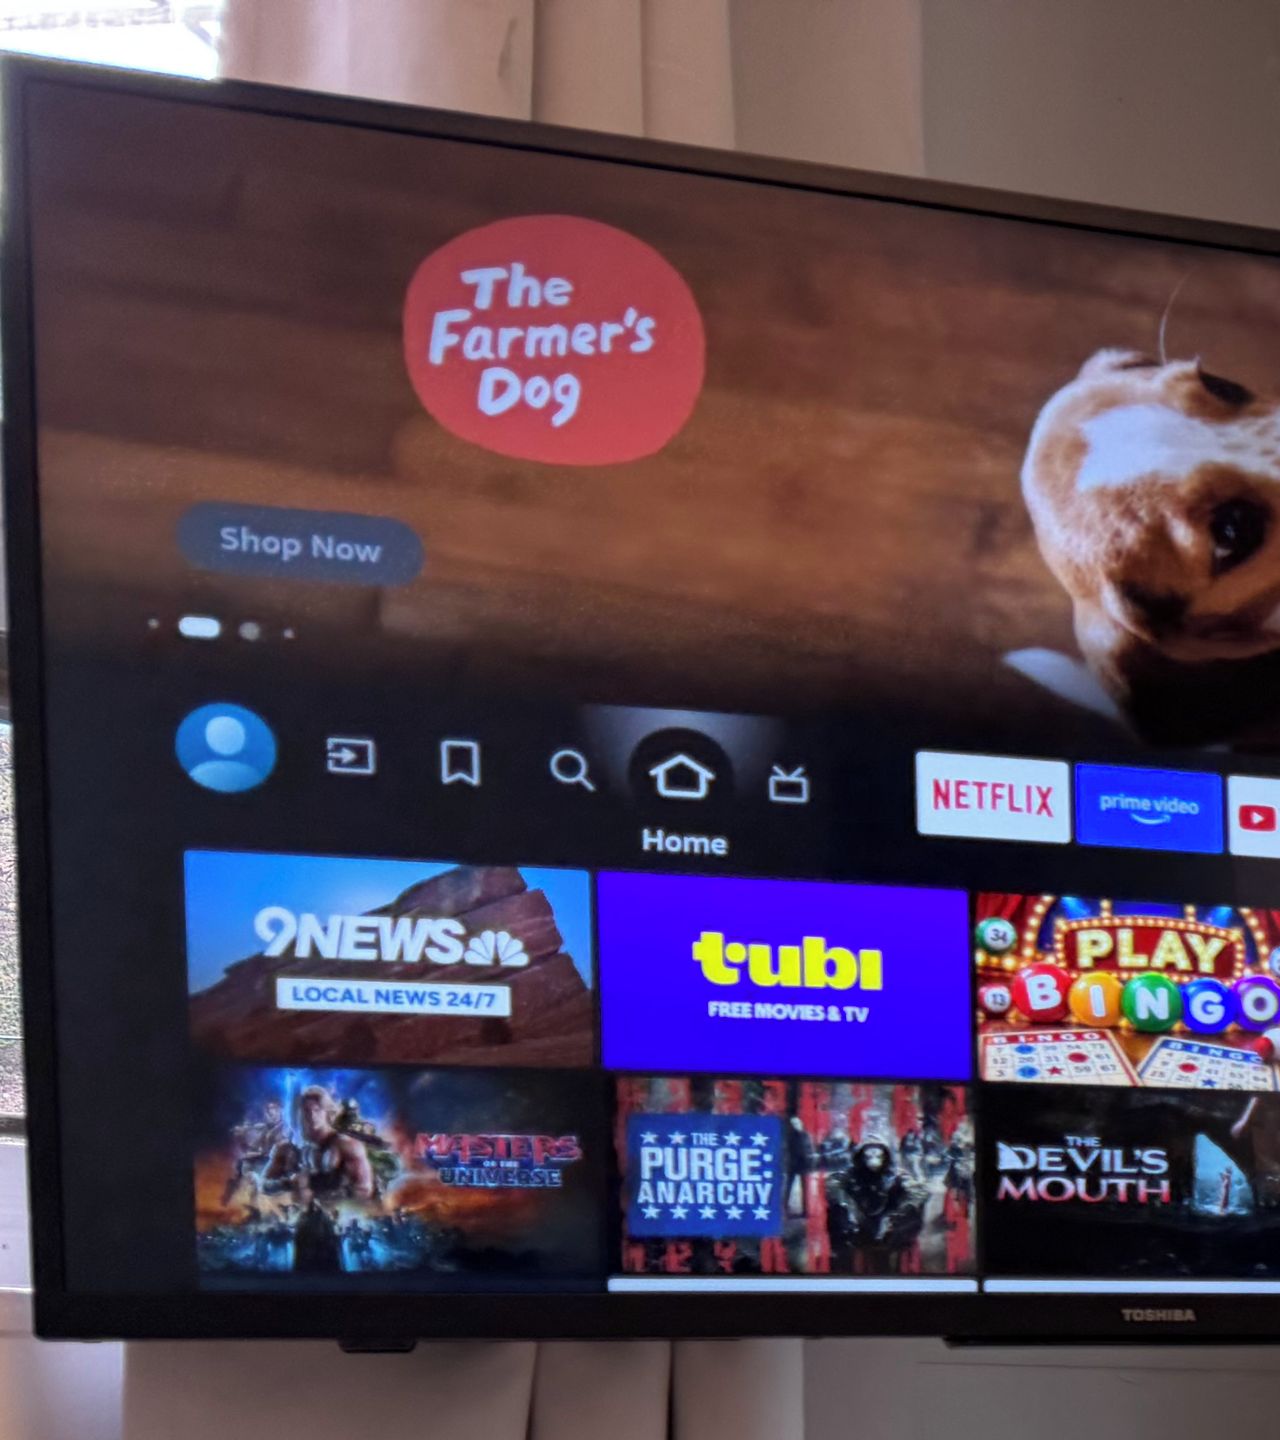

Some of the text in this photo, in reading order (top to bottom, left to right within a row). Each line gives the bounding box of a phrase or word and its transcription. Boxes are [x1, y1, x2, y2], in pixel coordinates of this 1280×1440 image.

[460, 262, 574, 310] The
[429, 307, 656, 366] Farmer's
[477, 367, 581, 428] Dog
[220, 526, 383, 563] Shop Now
[932, 778, 1054, 818] NETFLIX
[1100, 794, 1200, 815] prime video
[642, 828, 729, 856] Home
[254, 906, 466, 965] 9NEWS
[1077, 928, 1227, 974] PLAY
[692, 931, 882, 990] tubi
[292, 986, 496, 1009] LOCAL NEWS 24/7
[708, 1001, 869, 1023] FREE MOVIES & TV
[1025, 973, 1279, 1024] BINGO
[413, 1132, 583, 1166] MASTERS
[691, 1132, 719, 1147] THE
[1065, 1135, 1102, 1147] THE
[640, 1146, 774, 1182] PURGE:
[997, 1141, 1169, 1174] DEVIL'S
[438, 1166, 563, 1188] UNIVERSE
[637, 1181, 773, 1204] ANARCHY
[997, 1175, 1171, 1203] MOUTH
[1121, 1308, 1198, 1321] TOSHIBA
